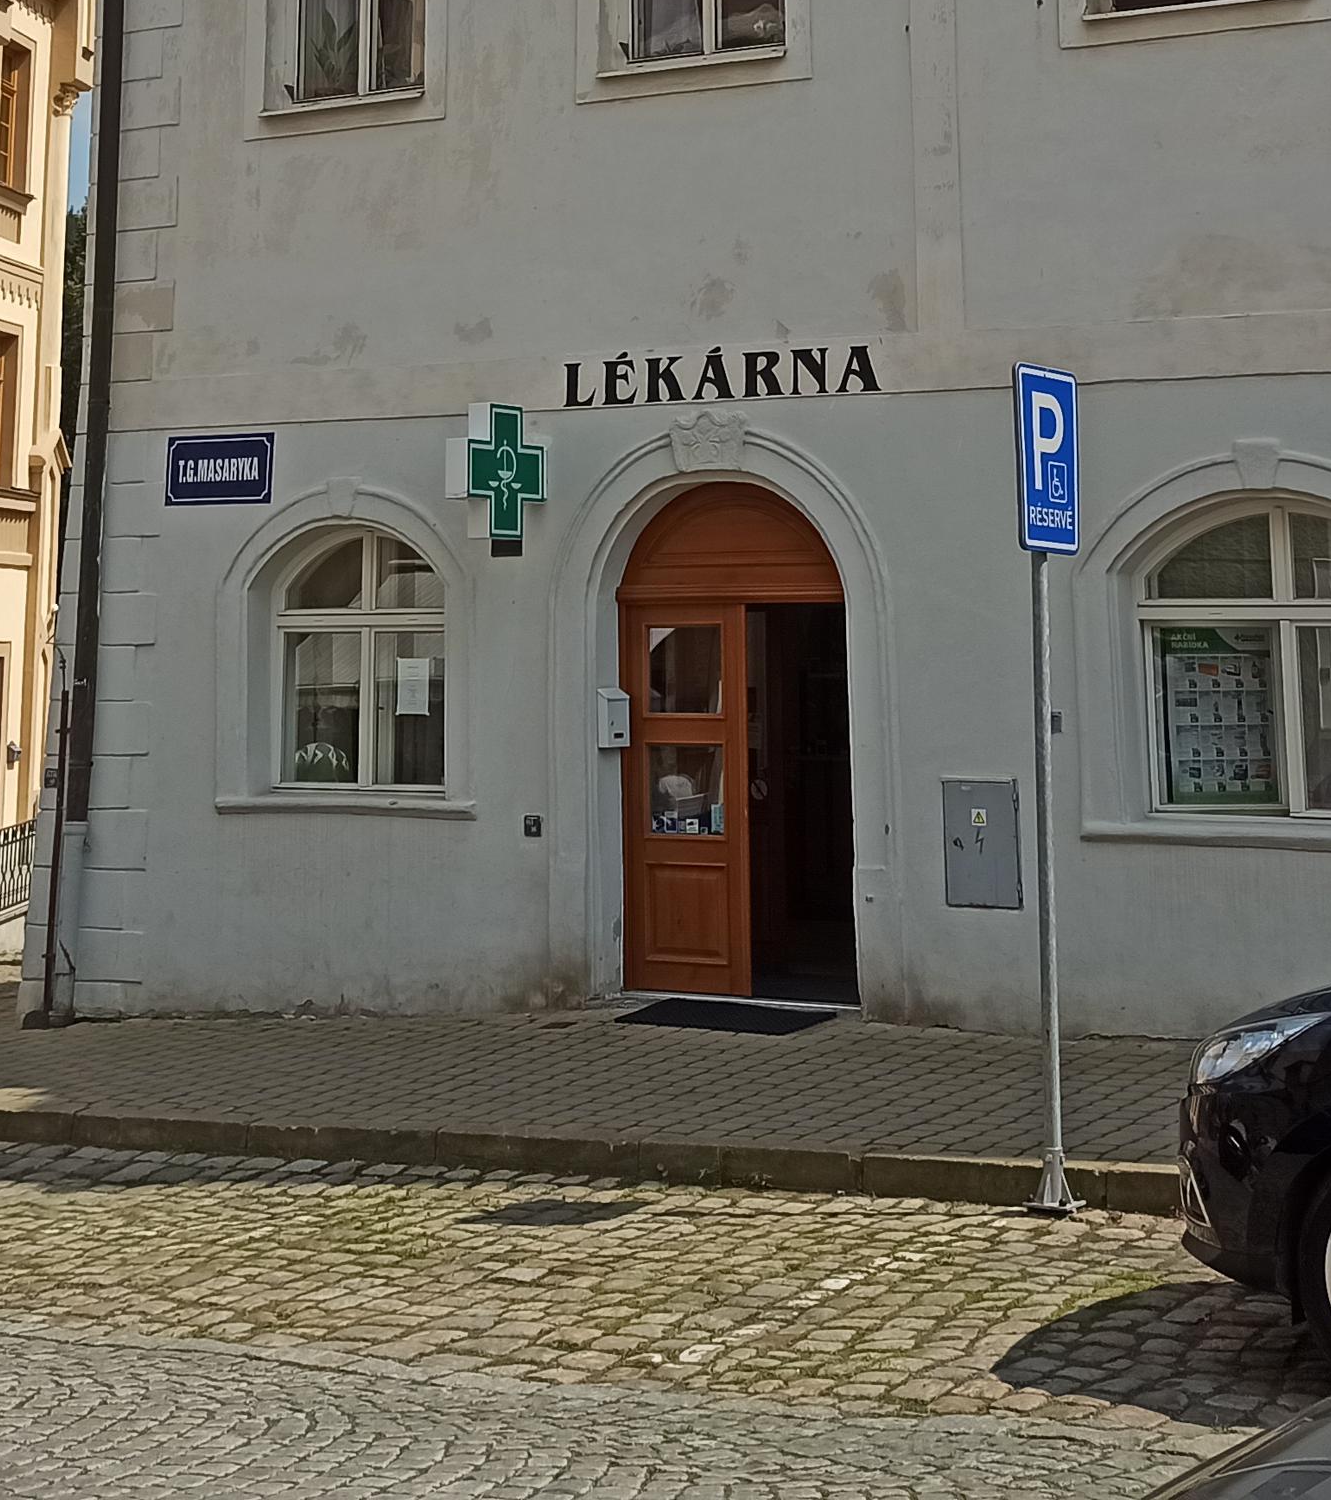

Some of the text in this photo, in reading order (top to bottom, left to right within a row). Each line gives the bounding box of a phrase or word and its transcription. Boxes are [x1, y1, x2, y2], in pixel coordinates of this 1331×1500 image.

[563, 346, 882, 407] LÉKÁRNA
[1031, 390, 1064, 490] P
[178, 457, 259, 483] T.G.MASARYKA
[1029, 502, 1073, 530] RÉSERVÉ
